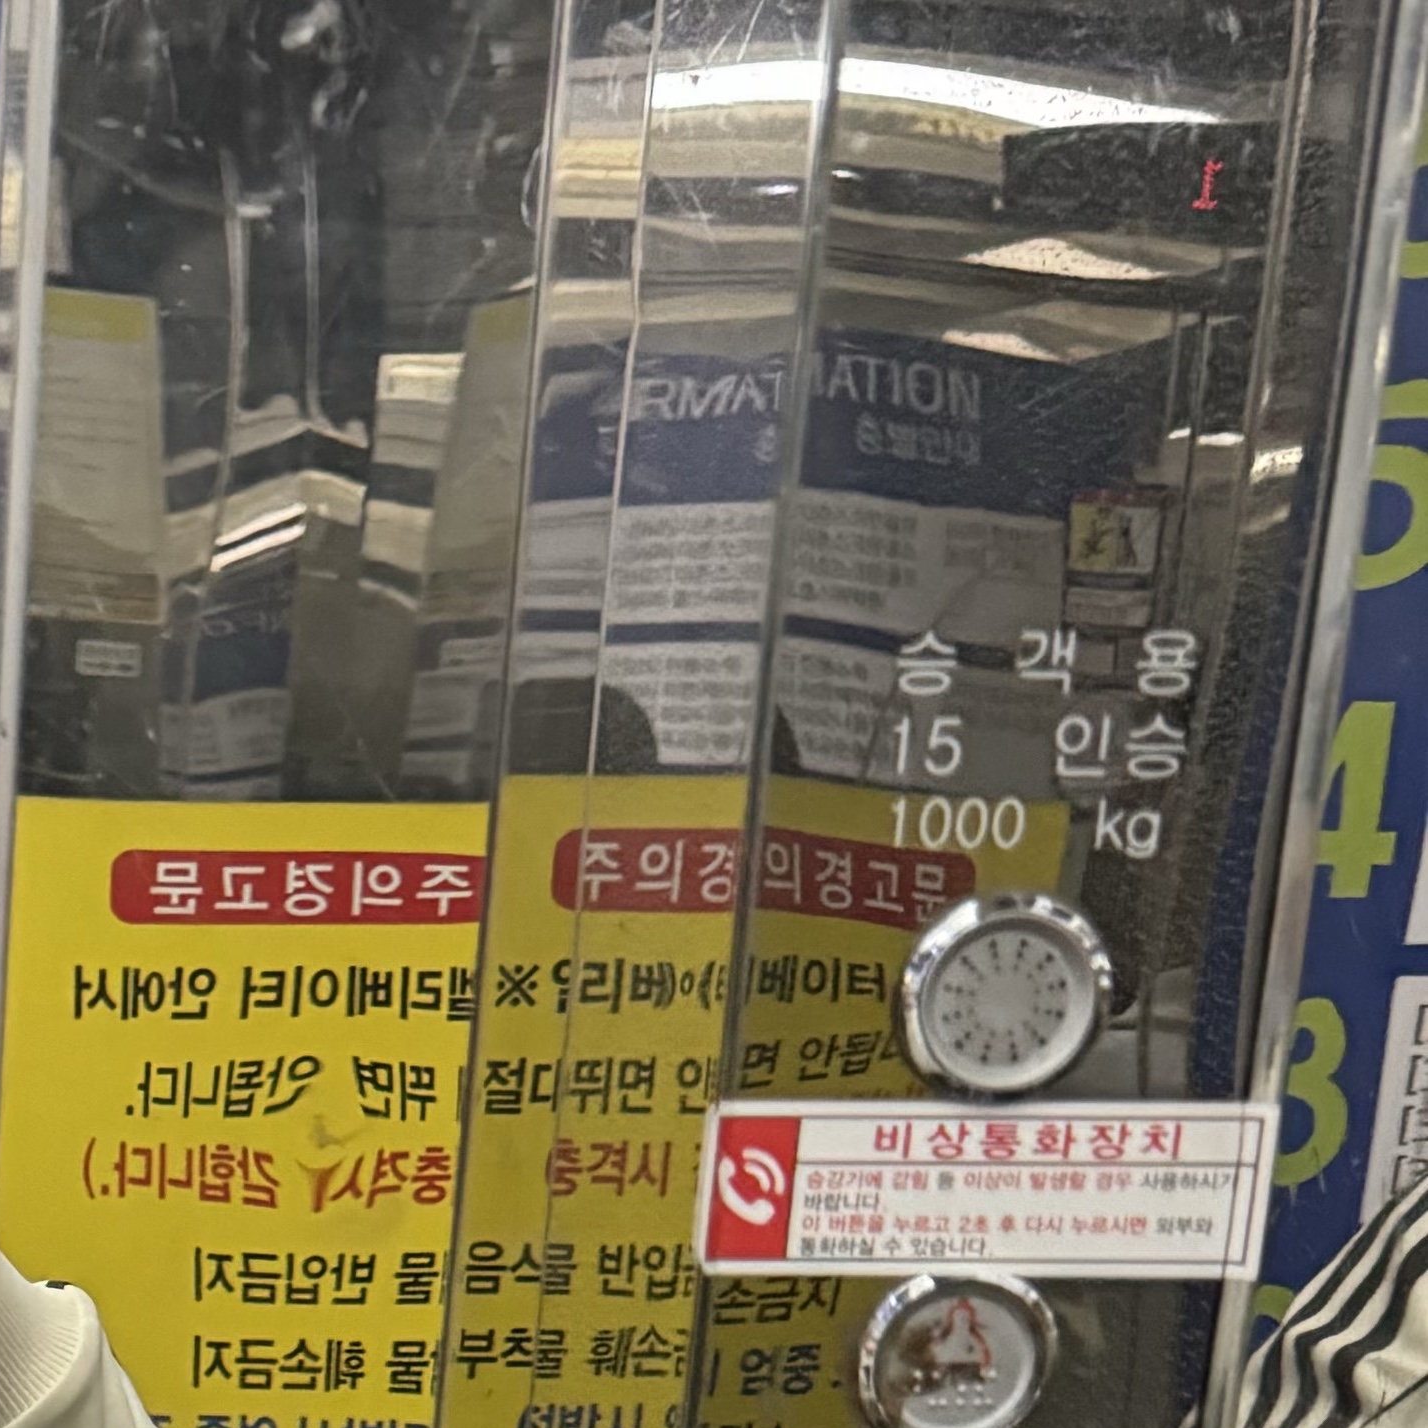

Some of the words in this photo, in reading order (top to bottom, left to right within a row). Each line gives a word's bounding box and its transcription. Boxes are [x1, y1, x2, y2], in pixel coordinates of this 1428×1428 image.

[893, 716, 963, 777] 15
[1056, 714, 1192, 780] 인승
[890, 799, 1026, 851] 1000
[1095, 800, 1166, 860] kg
[874, 1119, 1184, 1162] 비상통화장치
[807, 1170, 883, 1191] 승강기에
[964, 1170, 1021, 1191] 이상이
[893, 1214, 949, 1234] 누르고
[1024, 1214, 1064, 1235] 다시
